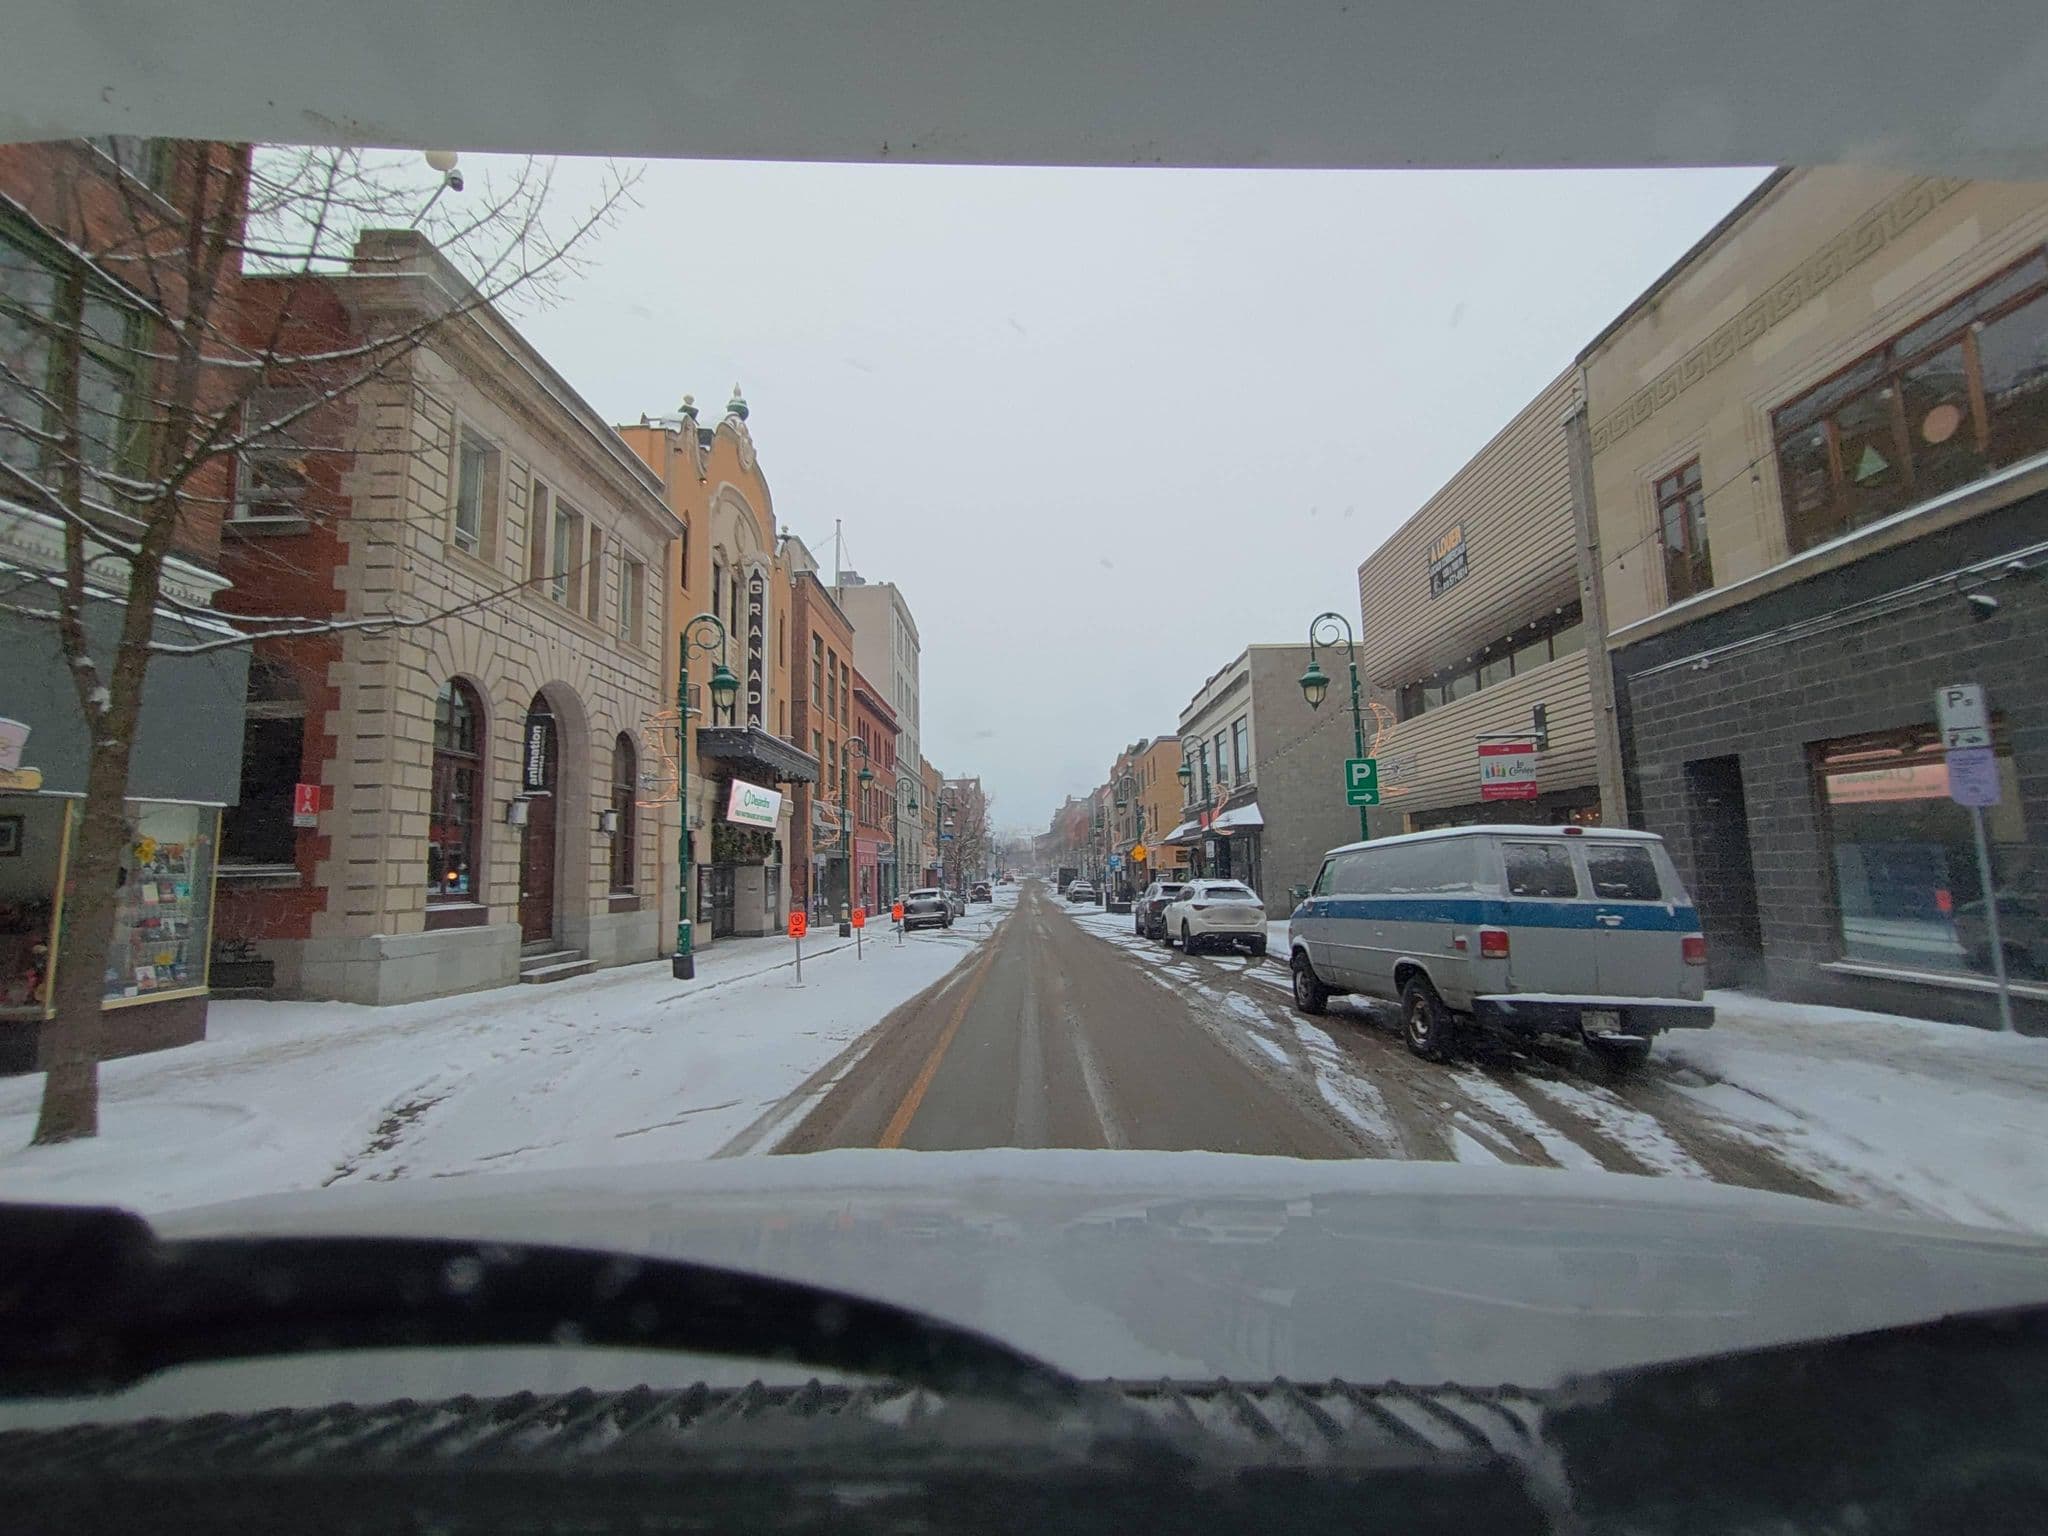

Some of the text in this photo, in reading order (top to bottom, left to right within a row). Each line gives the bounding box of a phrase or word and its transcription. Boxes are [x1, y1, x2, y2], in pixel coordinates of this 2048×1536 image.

[748, 580, 762, 726] GRANADA
[528, 725, 541, 785] animation
[1352, 763, 1371, 786] P
